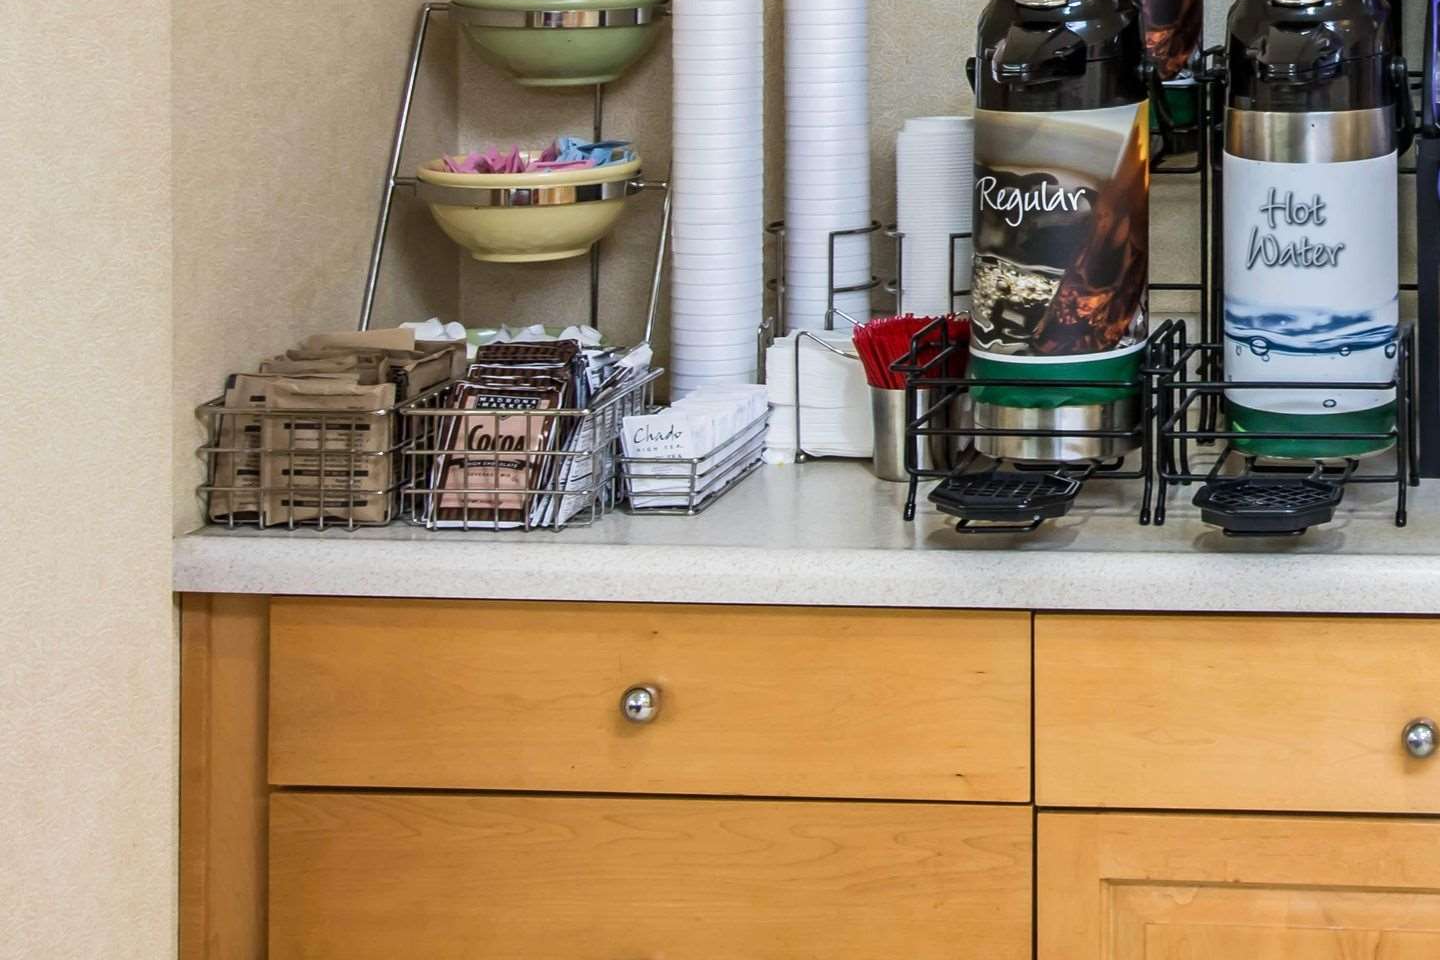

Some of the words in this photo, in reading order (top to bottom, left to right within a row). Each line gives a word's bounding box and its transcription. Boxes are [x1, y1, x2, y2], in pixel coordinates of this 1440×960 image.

[975, 175, 1087, 228] Regular
[1260, 186, 1327, 227] Hot
[1246, 226, 1345, 271] Water
[633, 424, 682, 444] Chado
